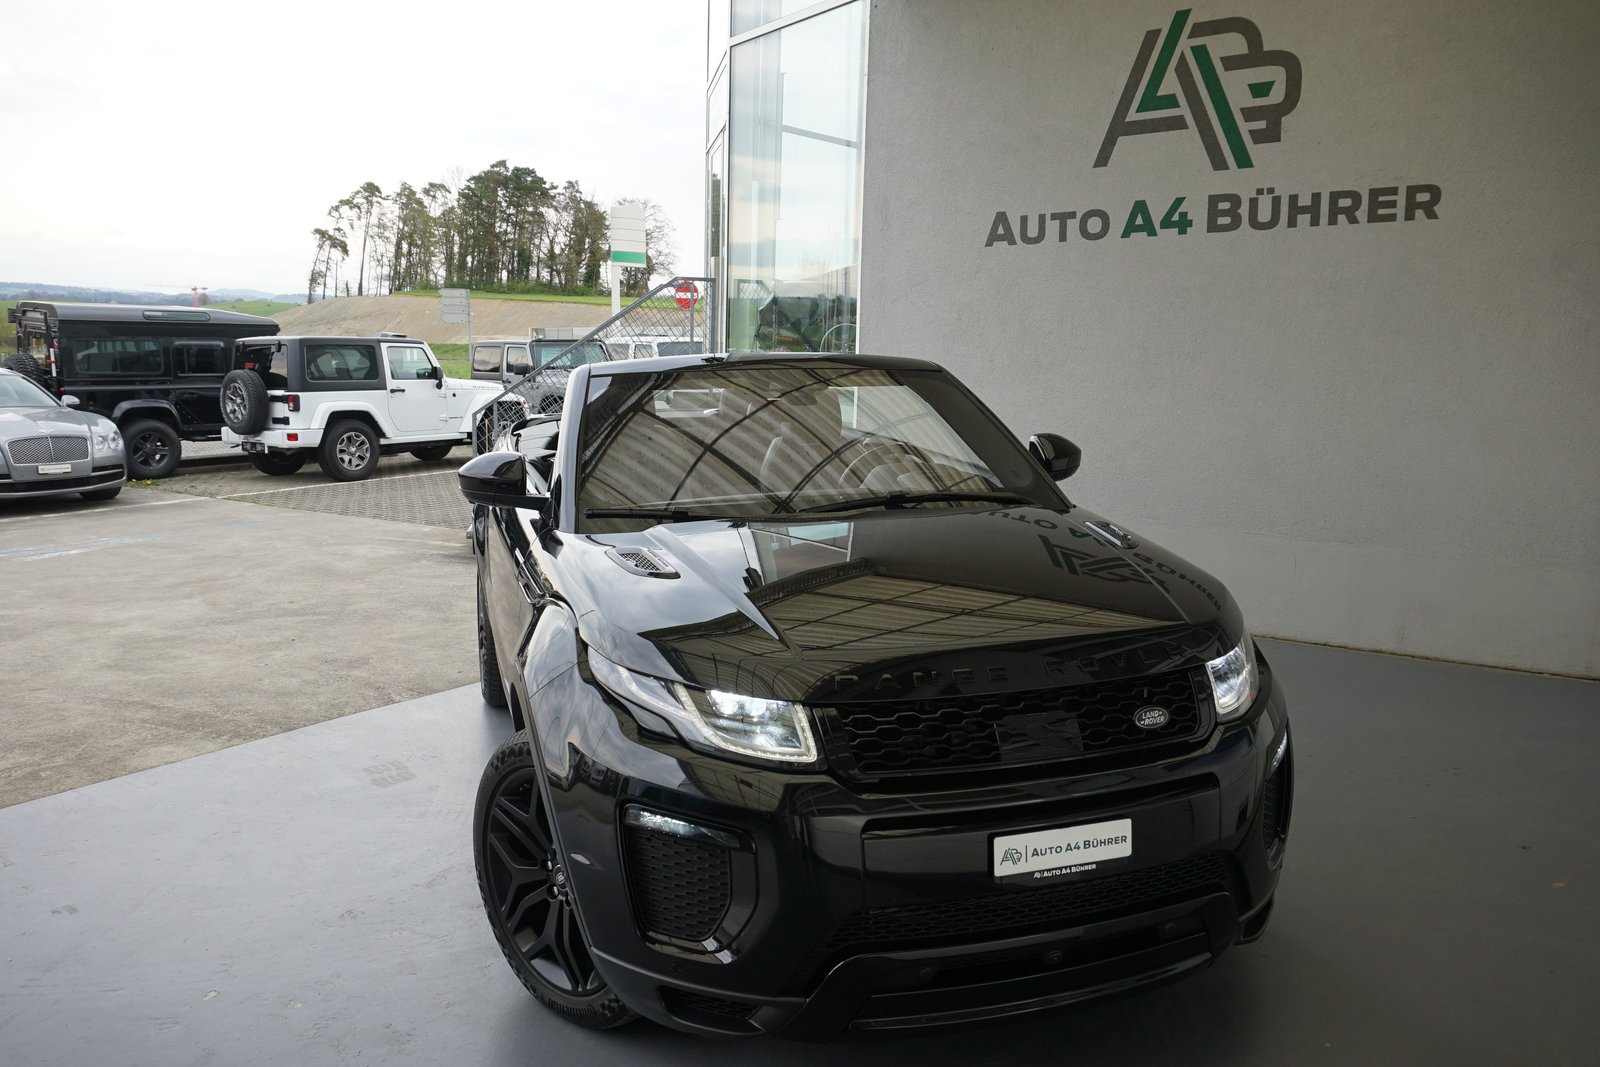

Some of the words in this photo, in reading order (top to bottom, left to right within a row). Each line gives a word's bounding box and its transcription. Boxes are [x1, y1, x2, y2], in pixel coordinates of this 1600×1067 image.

[984, 208, 1111, 248] AUTO
[1120, 196, 1194, 239] A4
[1205, 183, 1443, 234] BÜHRER
[834, 665, 1009, 692] RANGE
[1142, 710, 1158, 718] LAND
[1144, 716, 1164, 725] ROVER
[1031, 845, 1063, 858] AUTO
[1064, 842, 1081, 853] A4
[1083, 835, 1128, 850] BÜHRER
[1043, 869, 1061, 878] AUTO
[1061, 867, 1071, 875] A4
